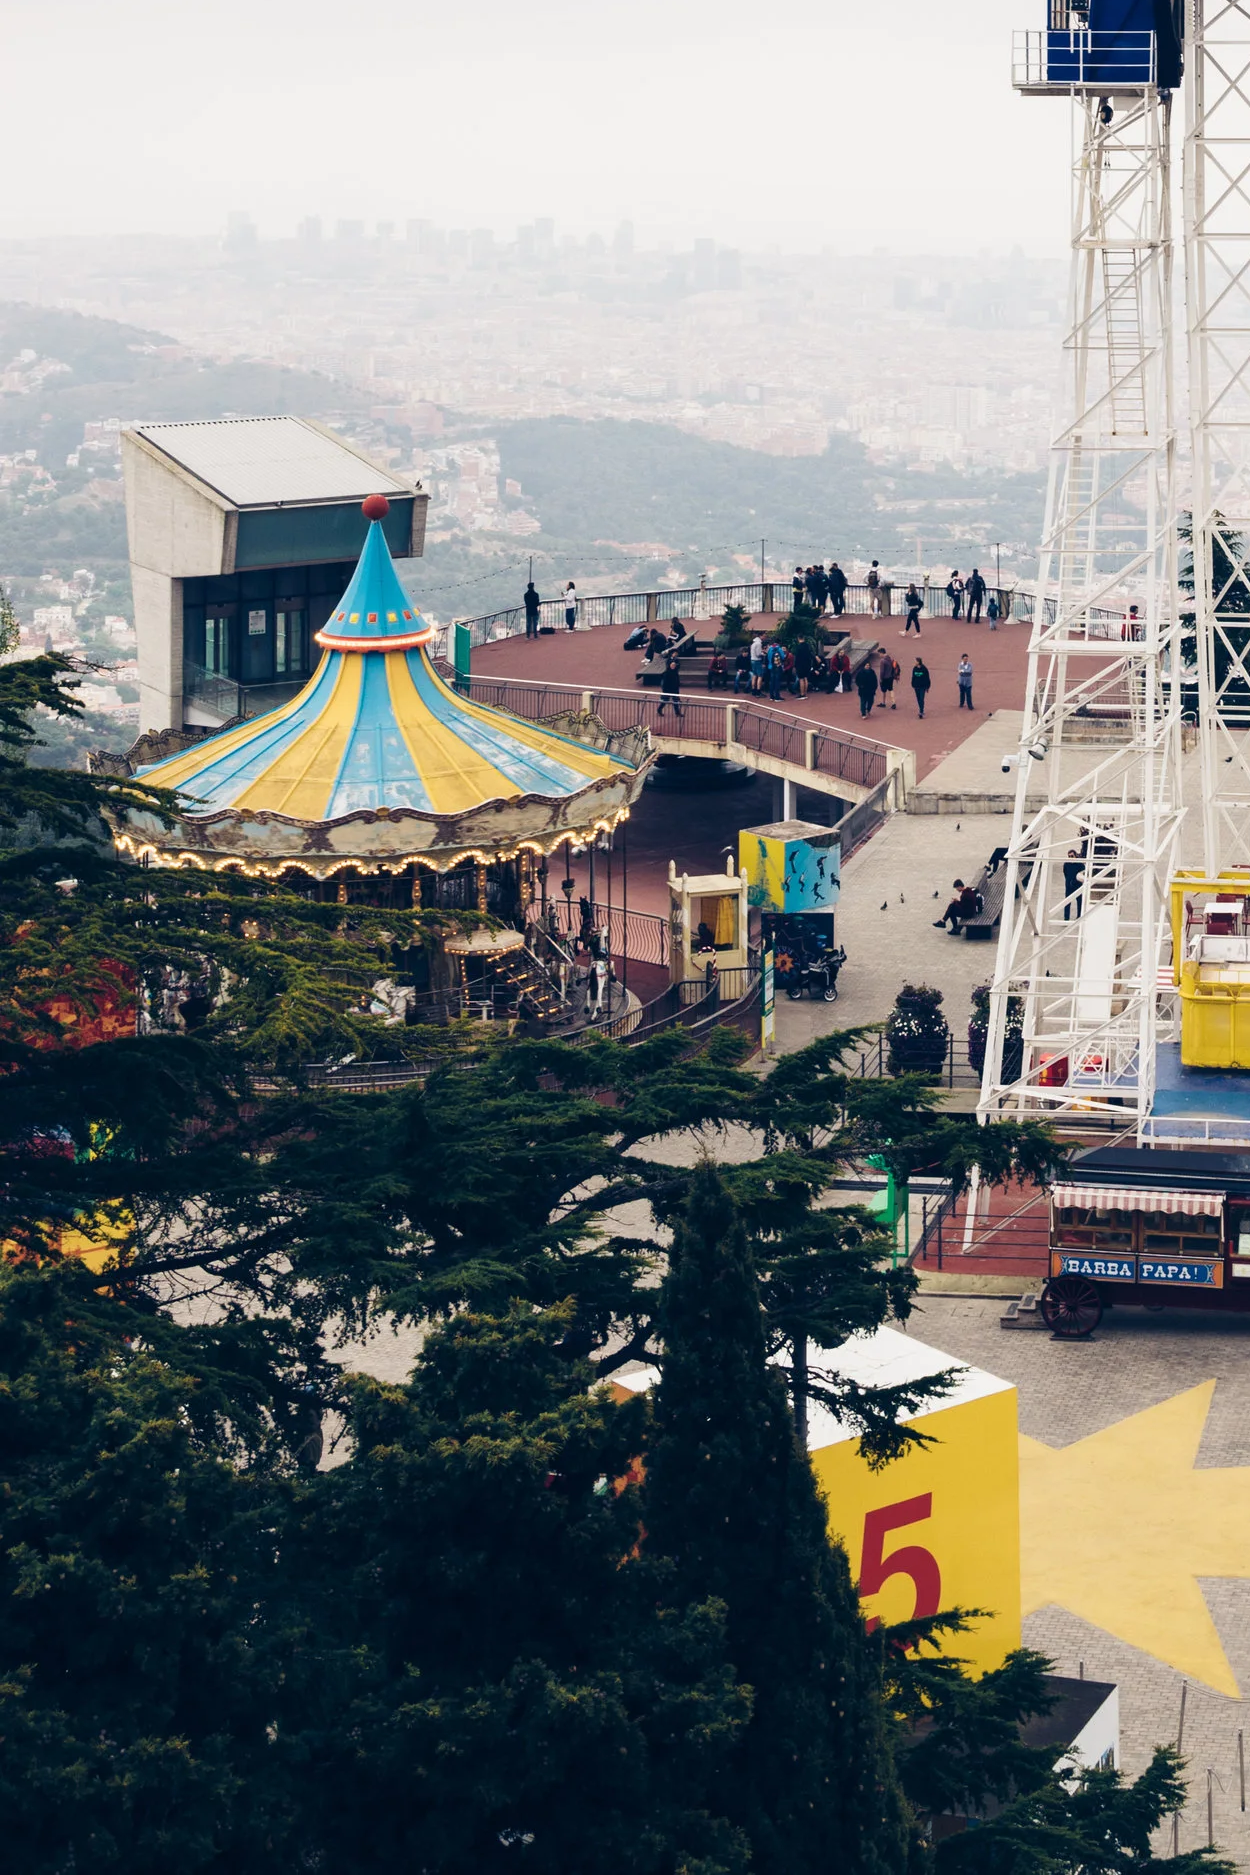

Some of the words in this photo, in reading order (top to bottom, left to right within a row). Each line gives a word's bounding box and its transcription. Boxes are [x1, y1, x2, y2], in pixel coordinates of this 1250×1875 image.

[1067, 1260, 1132, 1277] BARBA
[1143, 1264, 1198, 1280] PAPA!
[858, 1491, 942, 1655] 5
